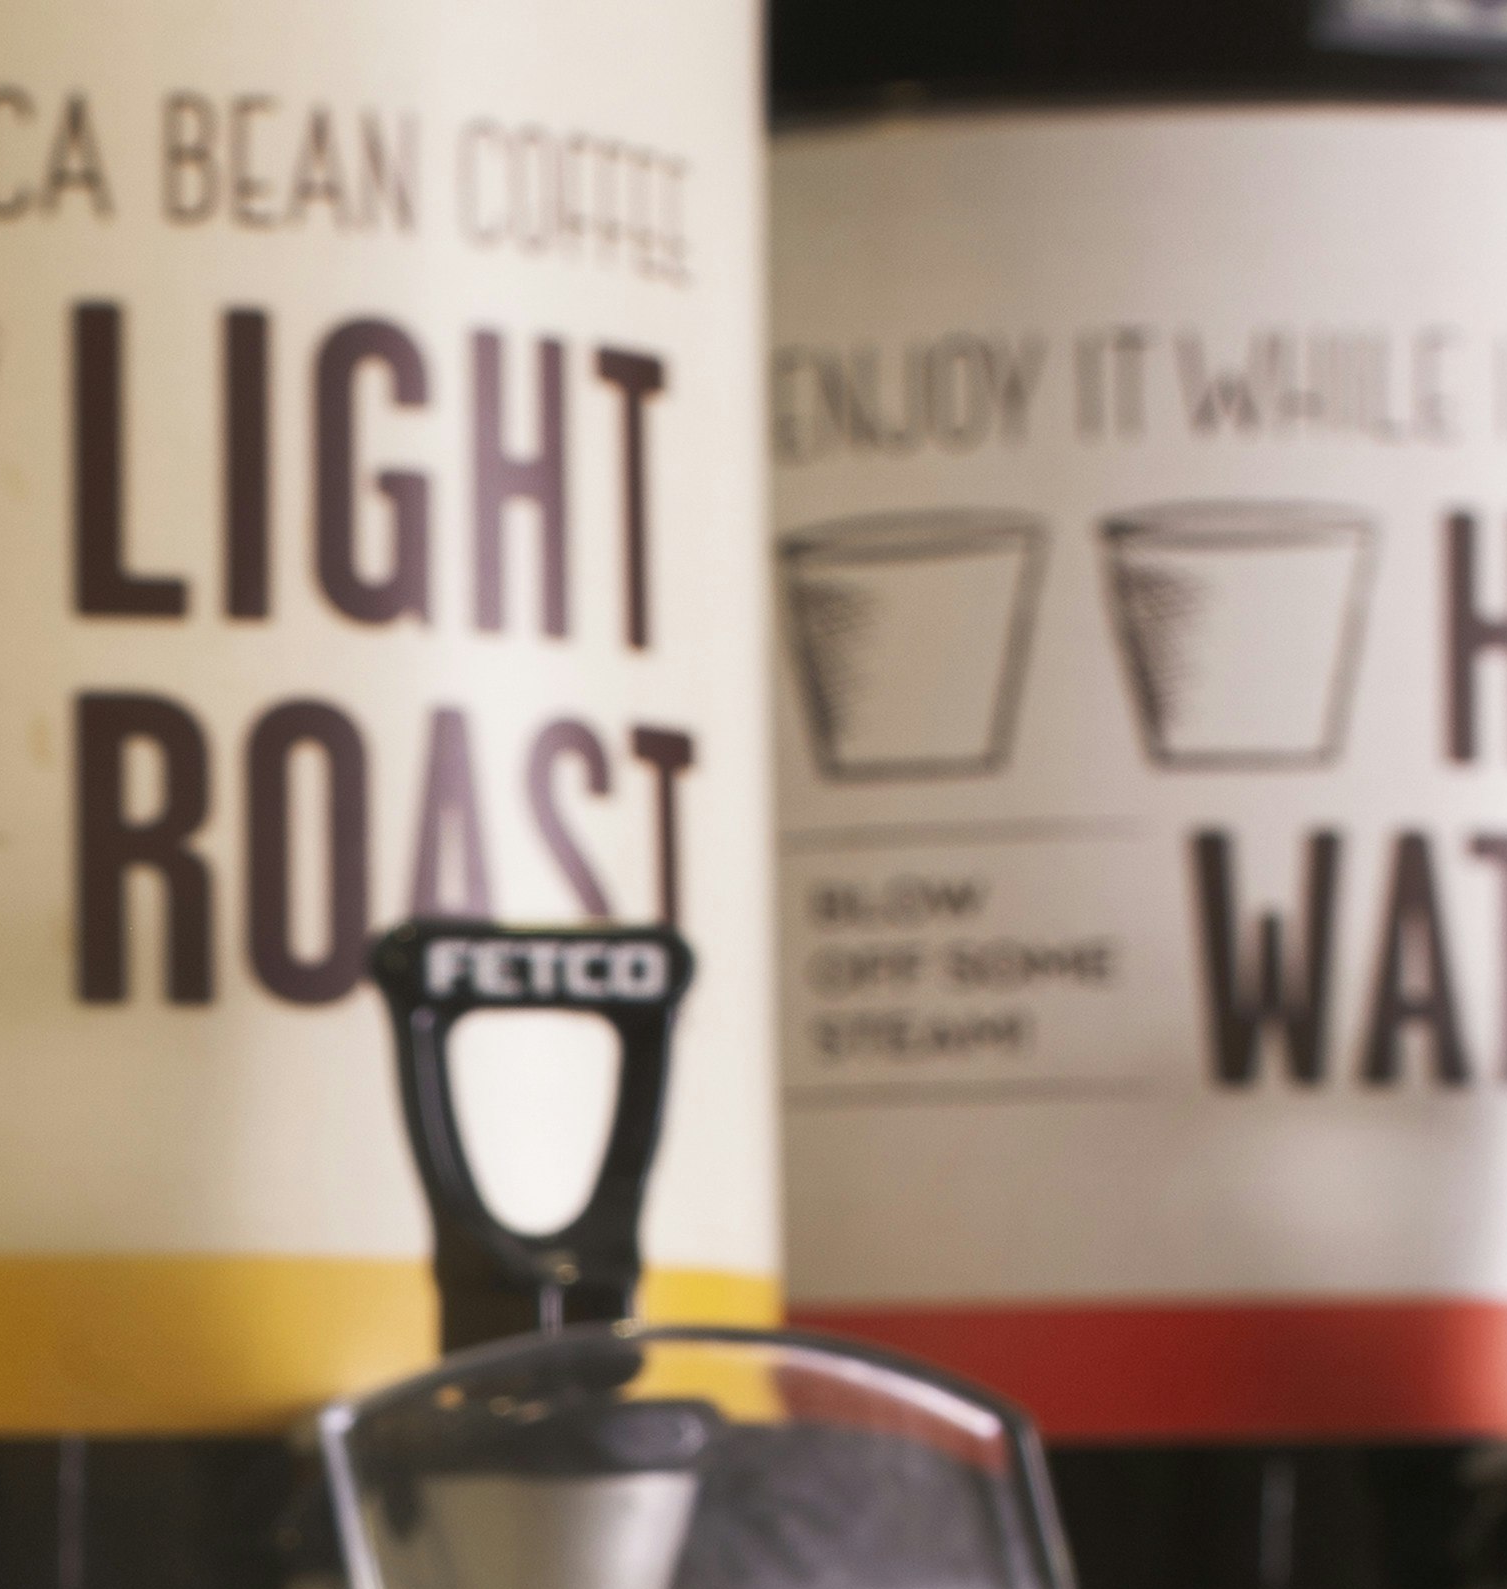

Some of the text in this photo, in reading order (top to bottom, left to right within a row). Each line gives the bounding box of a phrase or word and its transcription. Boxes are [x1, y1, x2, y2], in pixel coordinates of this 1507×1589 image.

[160, 91, 420, 238] BEAN
[455, 114, 693, 286] COFFEE
[68, 300, 668, 650] LIGHT
[771, 332, 1048, 465] ENJOY
[1073, 323, 1153, 445] IT
[1175, 321, 1464, 448] WHILE
[70, 689, 697, 1008] ROAST
[424, 936, 671, 1000] FETCO
